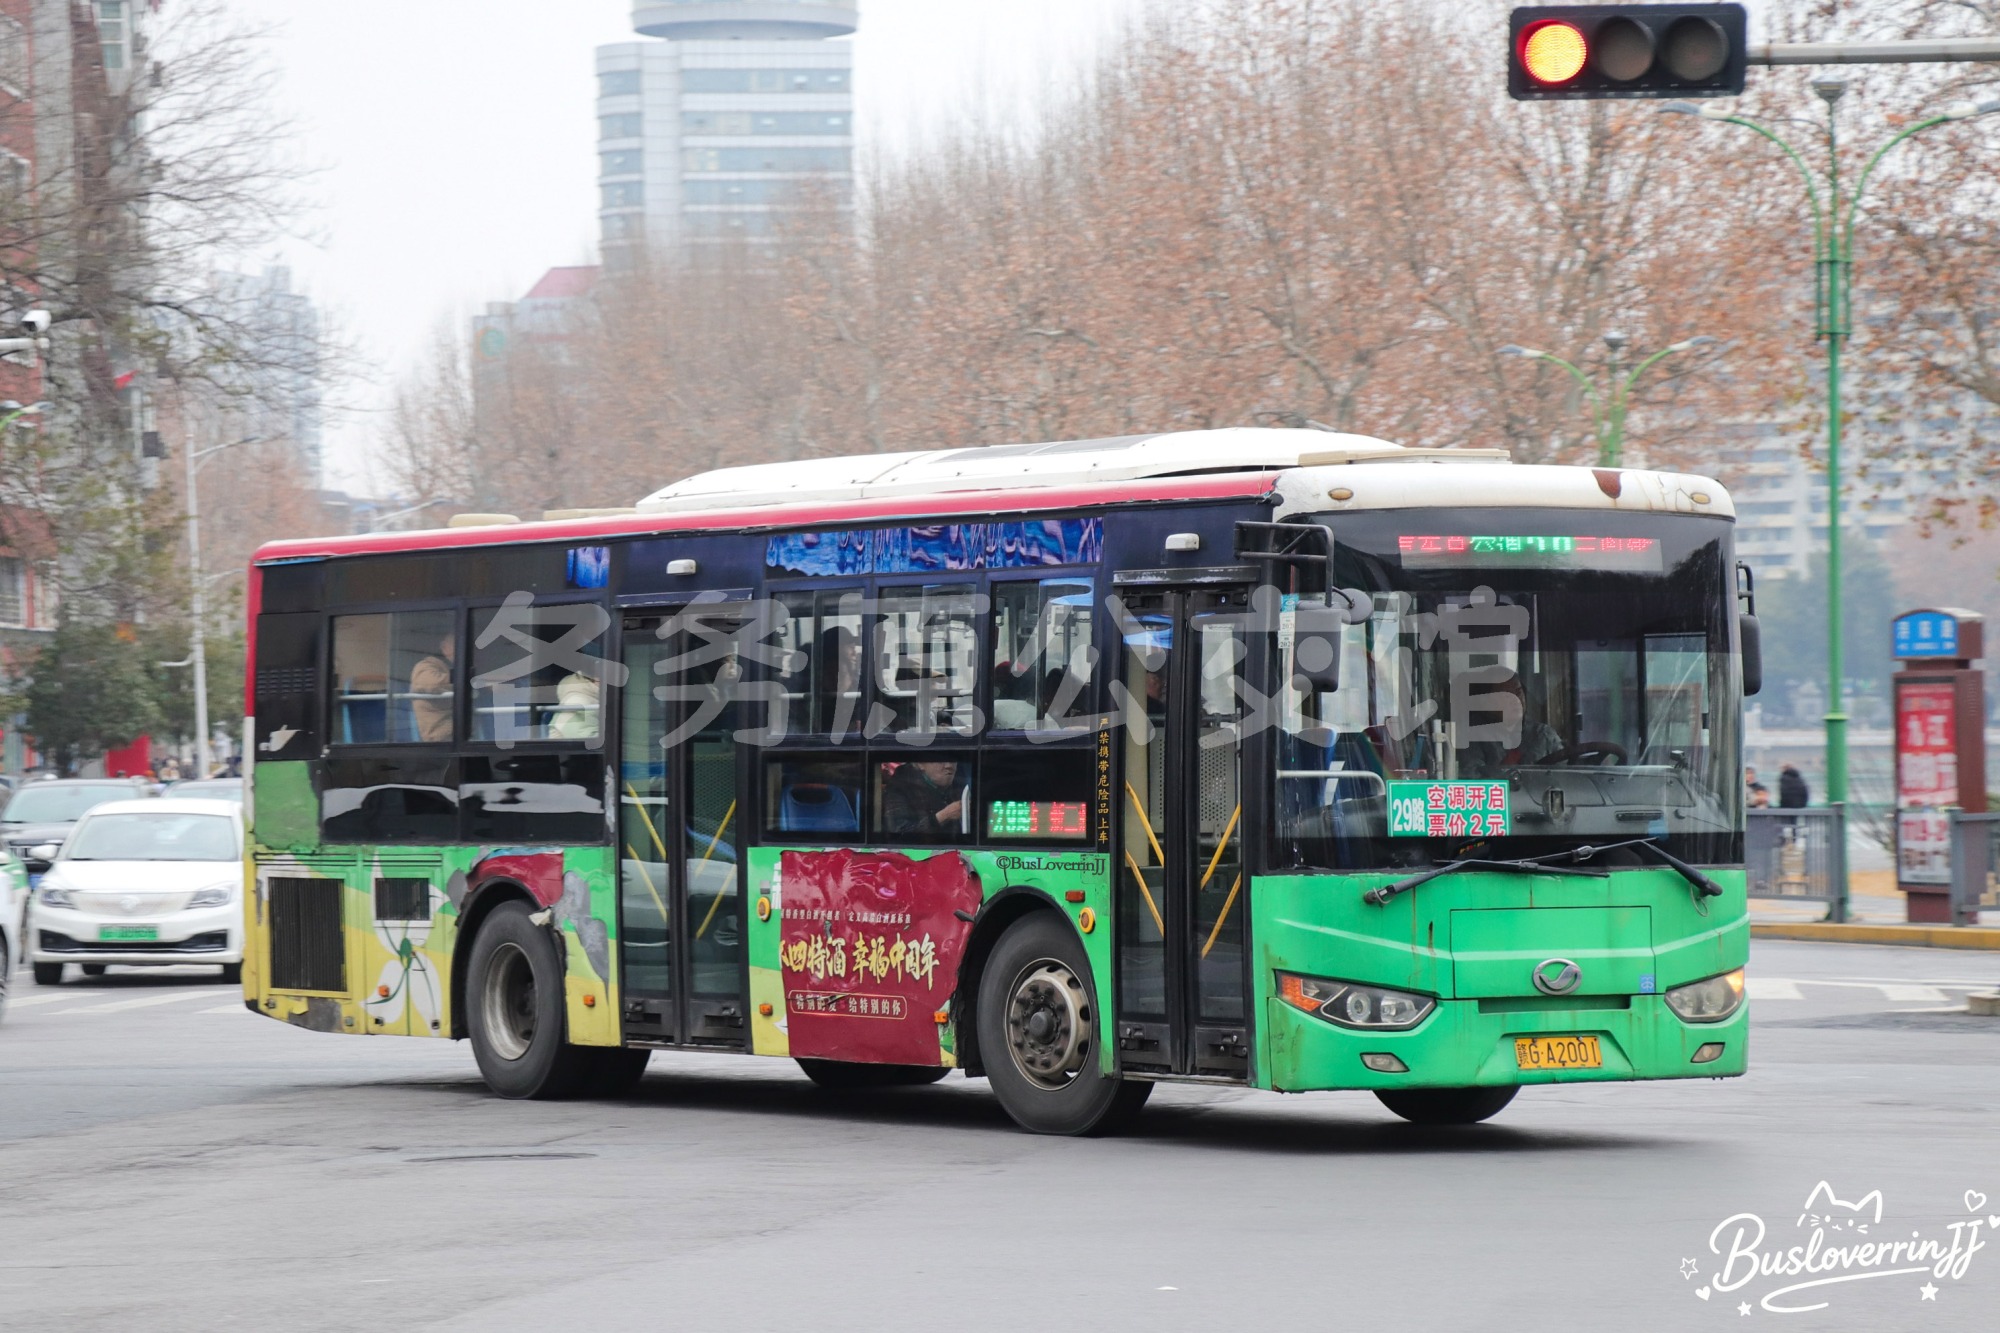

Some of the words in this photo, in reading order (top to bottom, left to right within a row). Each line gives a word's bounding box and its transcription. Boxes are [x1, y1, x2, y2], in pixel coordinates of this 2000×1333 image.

[1097, 717, 1110, 844] 严禁携带危险品上车
[1427, 784, 1506, 810] 空调开启
[1393, 798, 1426, 832] 29路
[1427, 813, 1506, 837] 票价2元
